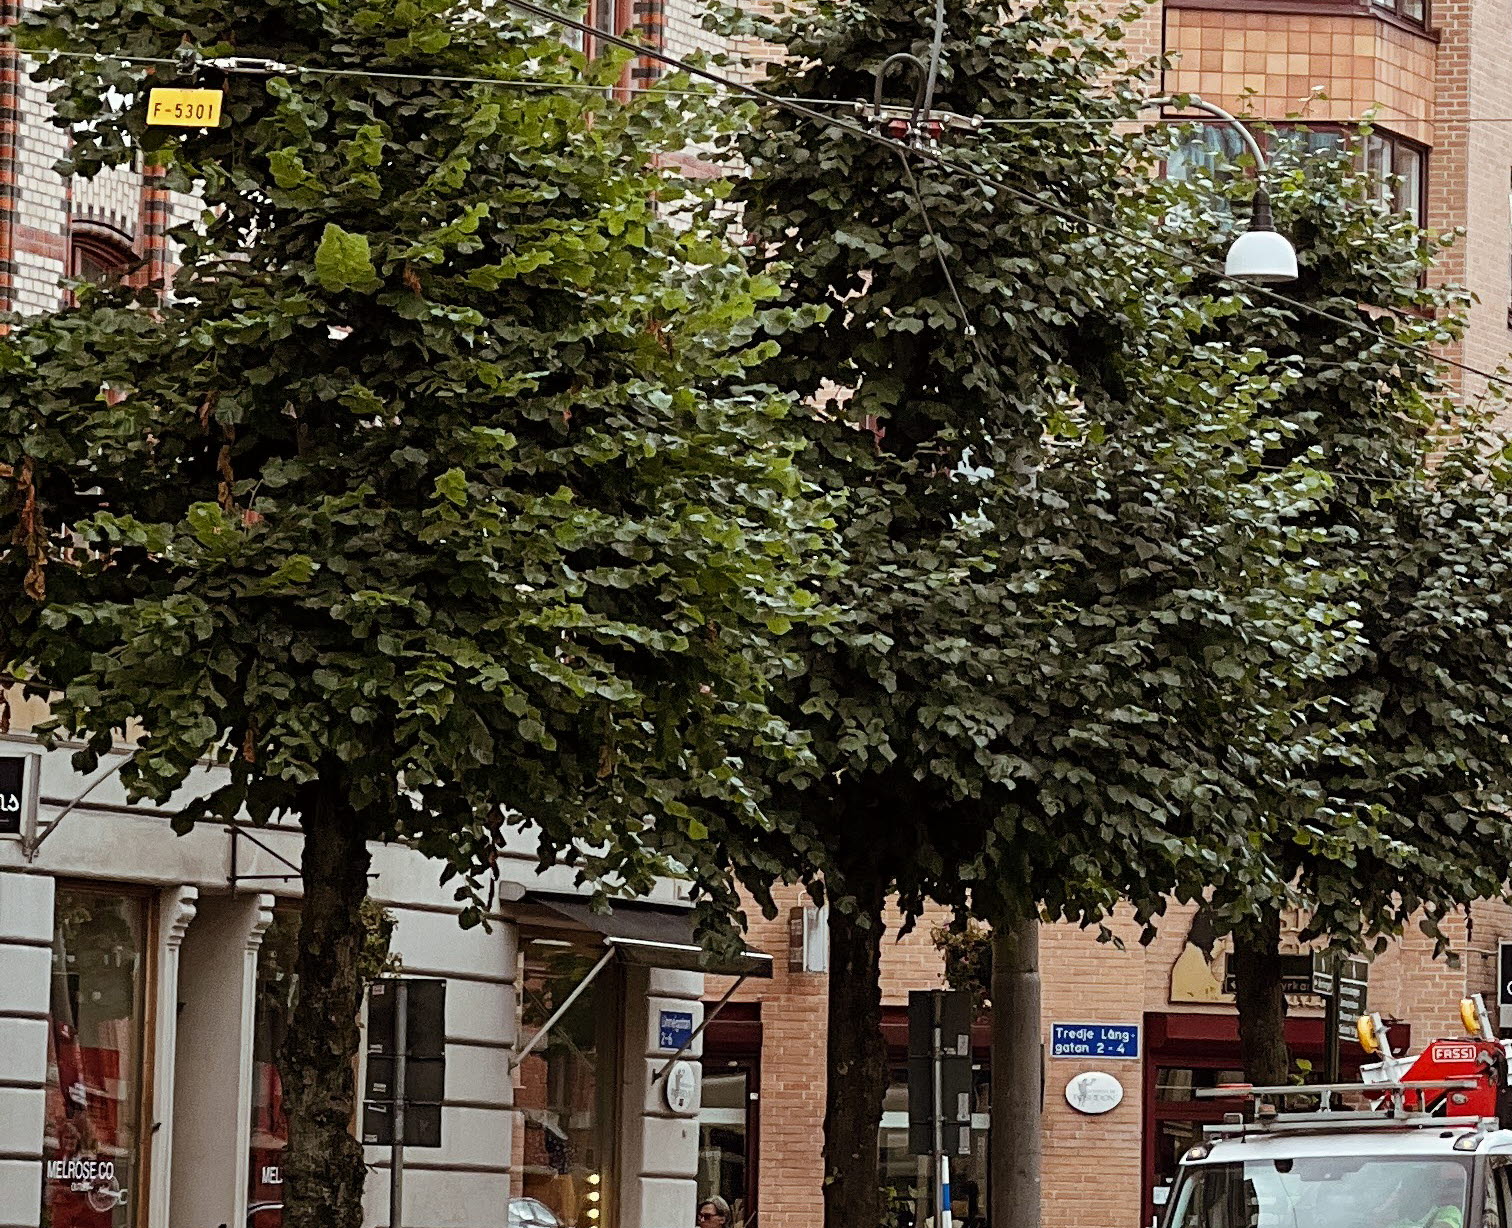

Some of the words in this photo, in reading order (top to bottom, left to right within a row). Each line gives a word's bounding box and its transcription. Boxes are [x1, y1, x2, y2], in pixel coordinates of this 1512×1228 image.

[153, 102, 213, 119] F-5301
[1055, 1027, 1095, 1042] Tredje
[1055, 1042, 1090, 1054] gatan
[1436, 1048, 1474, 1059] FASSI
[47, 1160, 97, 1179] MELROSE
[98, 1161, 114, 1180] CO
[262, 1166, 284, 1184] MEL
